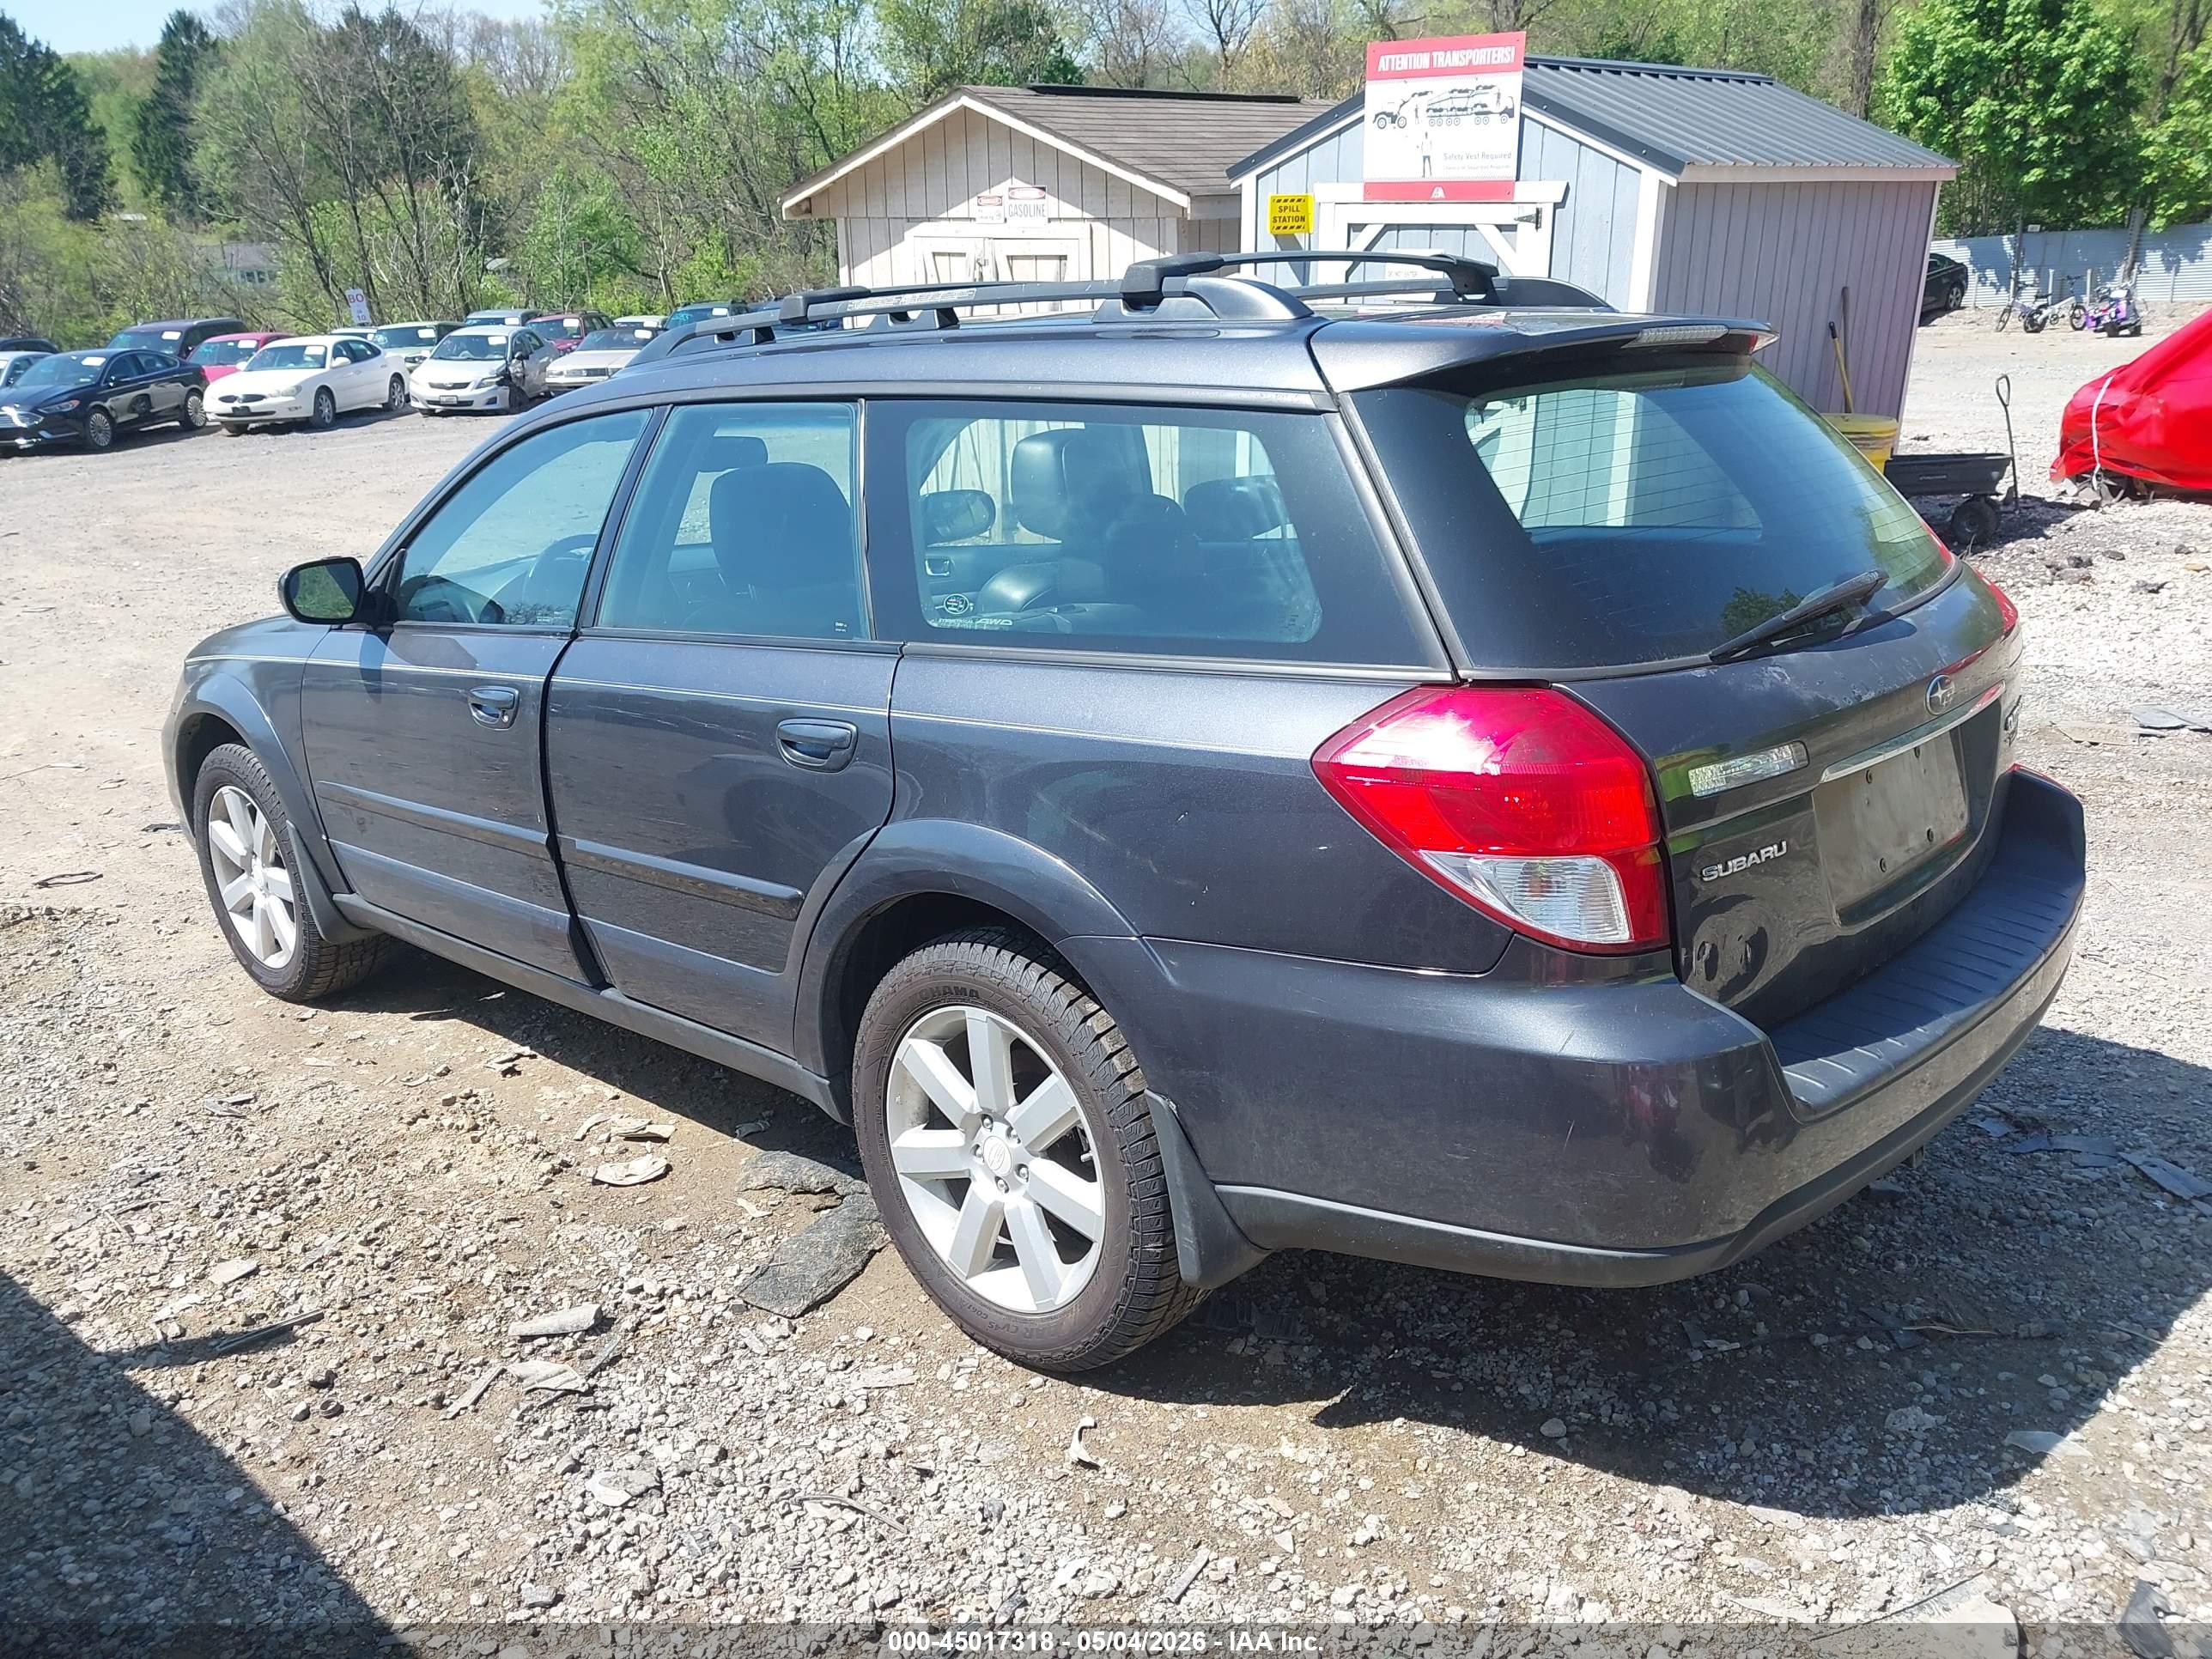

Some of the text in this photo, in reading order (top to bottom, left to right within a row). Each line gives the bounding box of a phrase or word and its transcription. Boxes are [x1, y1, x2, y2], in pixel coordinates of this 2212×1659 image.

[1378, 46, 1516, 71] ATTENTION TRANSPORTERS!
[1443, 150, 1512, 161] Safety Vest Required
[1008, 204, 1047, 218] GASOLINE
[1278, 205, 1300, 214] SPILL
[1702, 840, 1787, 882] SUBARU
